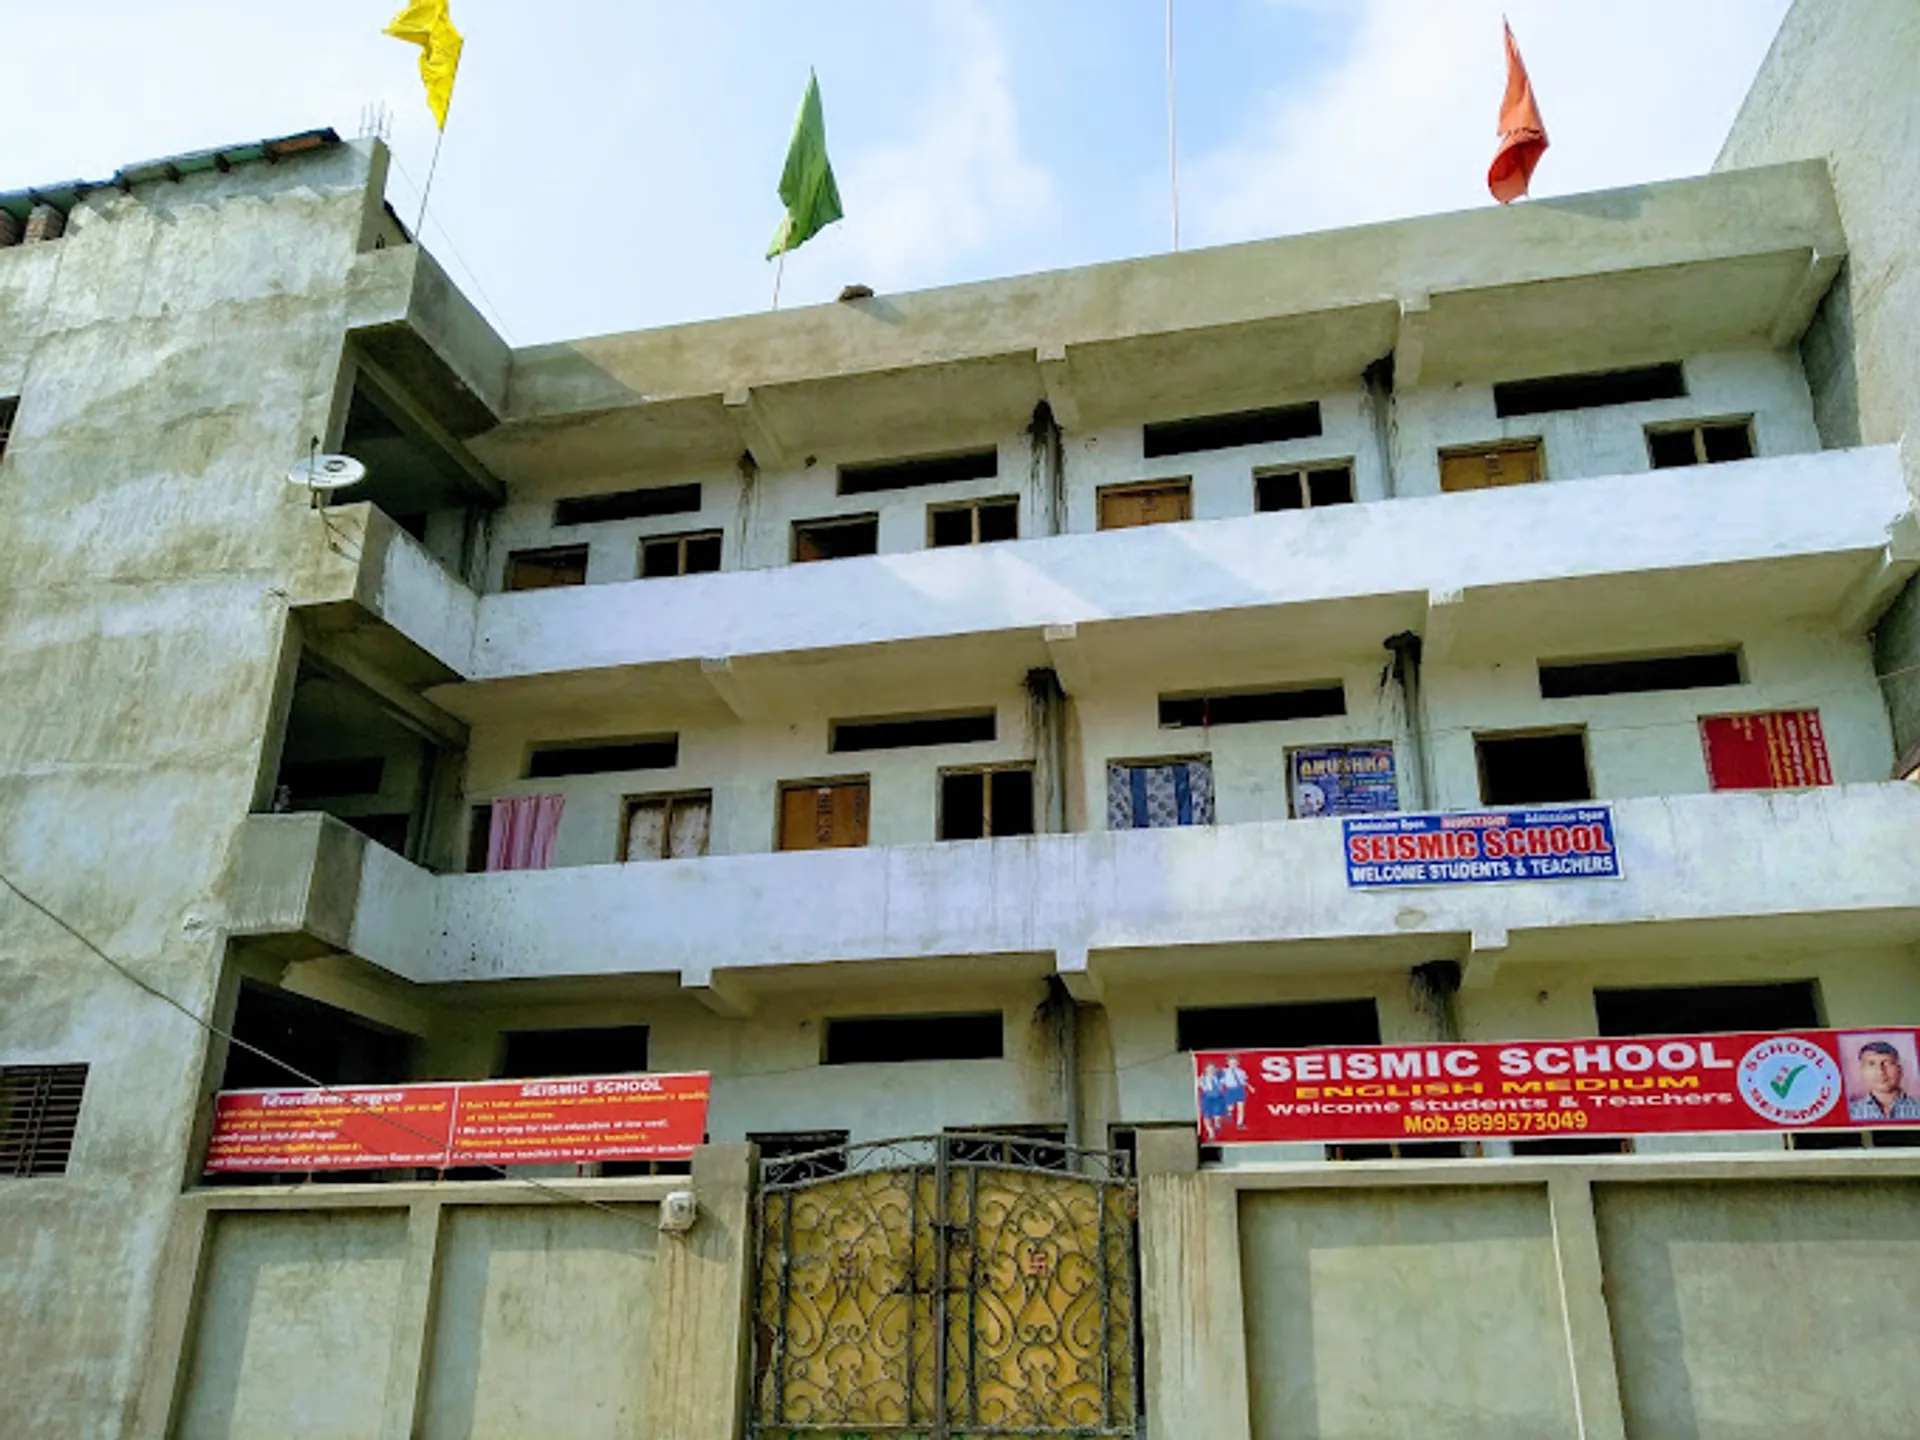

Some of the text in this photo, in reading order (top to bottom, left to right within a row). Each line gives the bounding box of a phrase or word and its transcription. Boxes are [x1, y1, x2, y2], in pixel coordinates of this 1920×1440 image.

[1349, 823, 1611, 864] SEISMIC SCHOOL
[1351, 855, 1614, 882] WELCOME STUDENTS & TEACHERS
[1260, 1042, 1734, 1083] SEISMIC SCHOOL
[1744, 1041, 1826, 1072] SCHOOL
[520, 1078, 663, 1097] SEISMIC SCHOOL
[1295, 1075, 1700, 1100] ENGLISH MEDIUM
[1559, 1095, 1580, 1108] &
[1588, 1091, 1734, 1108] Teachers
